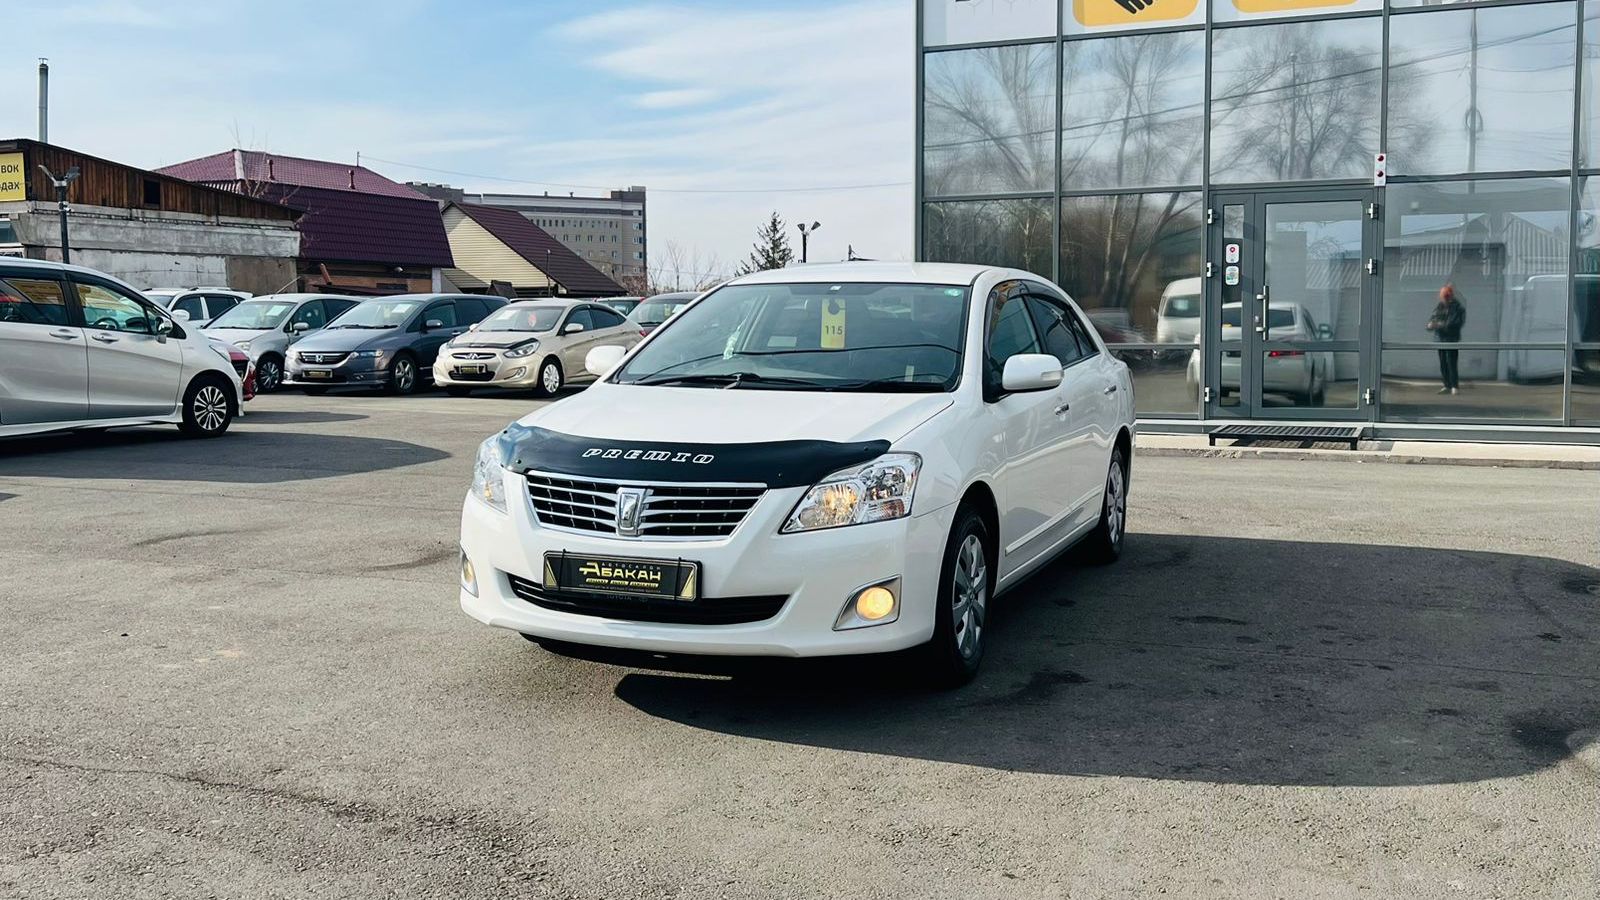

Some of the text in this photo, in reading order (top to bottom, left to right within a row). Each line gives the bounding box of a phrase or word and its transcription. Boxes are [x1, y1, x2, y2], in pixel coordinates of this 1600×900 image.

[0, 181, 20, 192] дах
[825, 325, 843, 335] 115
[582, 448, 715, 464] PREMIO
[579, 561, 661, 581] АБАКАН
